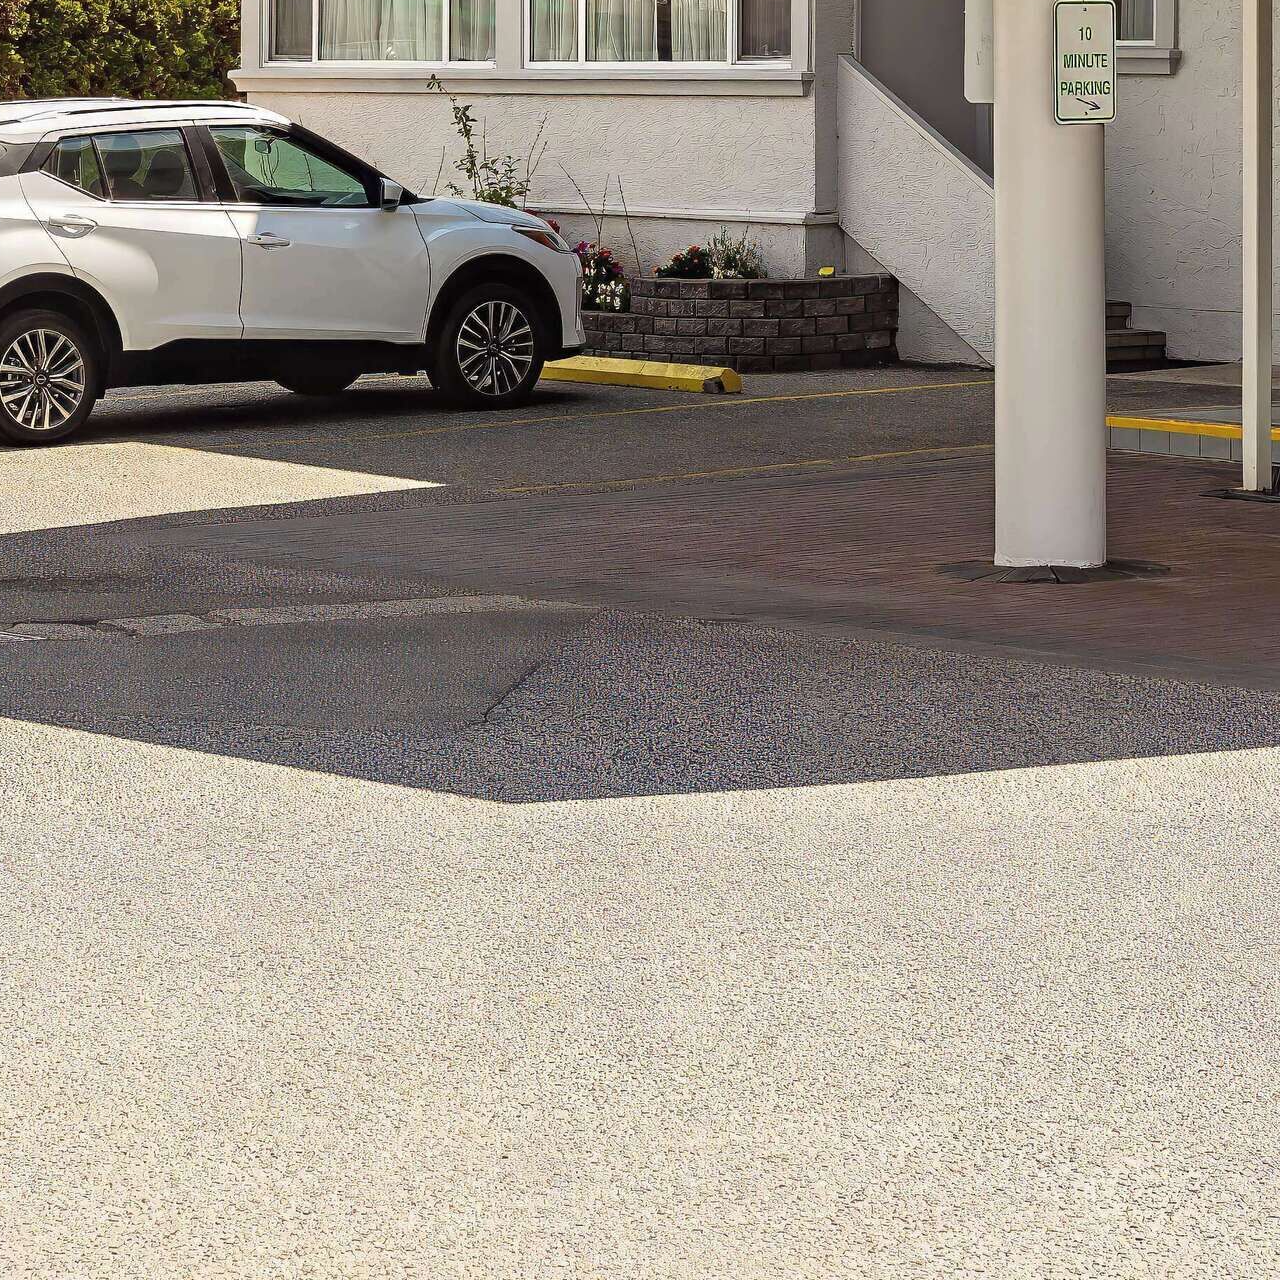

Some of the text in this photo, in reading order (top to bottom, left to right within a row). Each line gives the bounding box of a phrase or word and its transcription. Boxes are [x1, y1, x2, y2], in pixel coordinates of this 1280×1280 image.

[1078, 26, 1092, 41] 10
[1063, 54, 1108, 68] MINUTE
[1060, 81, 1111, 97] PARKING
